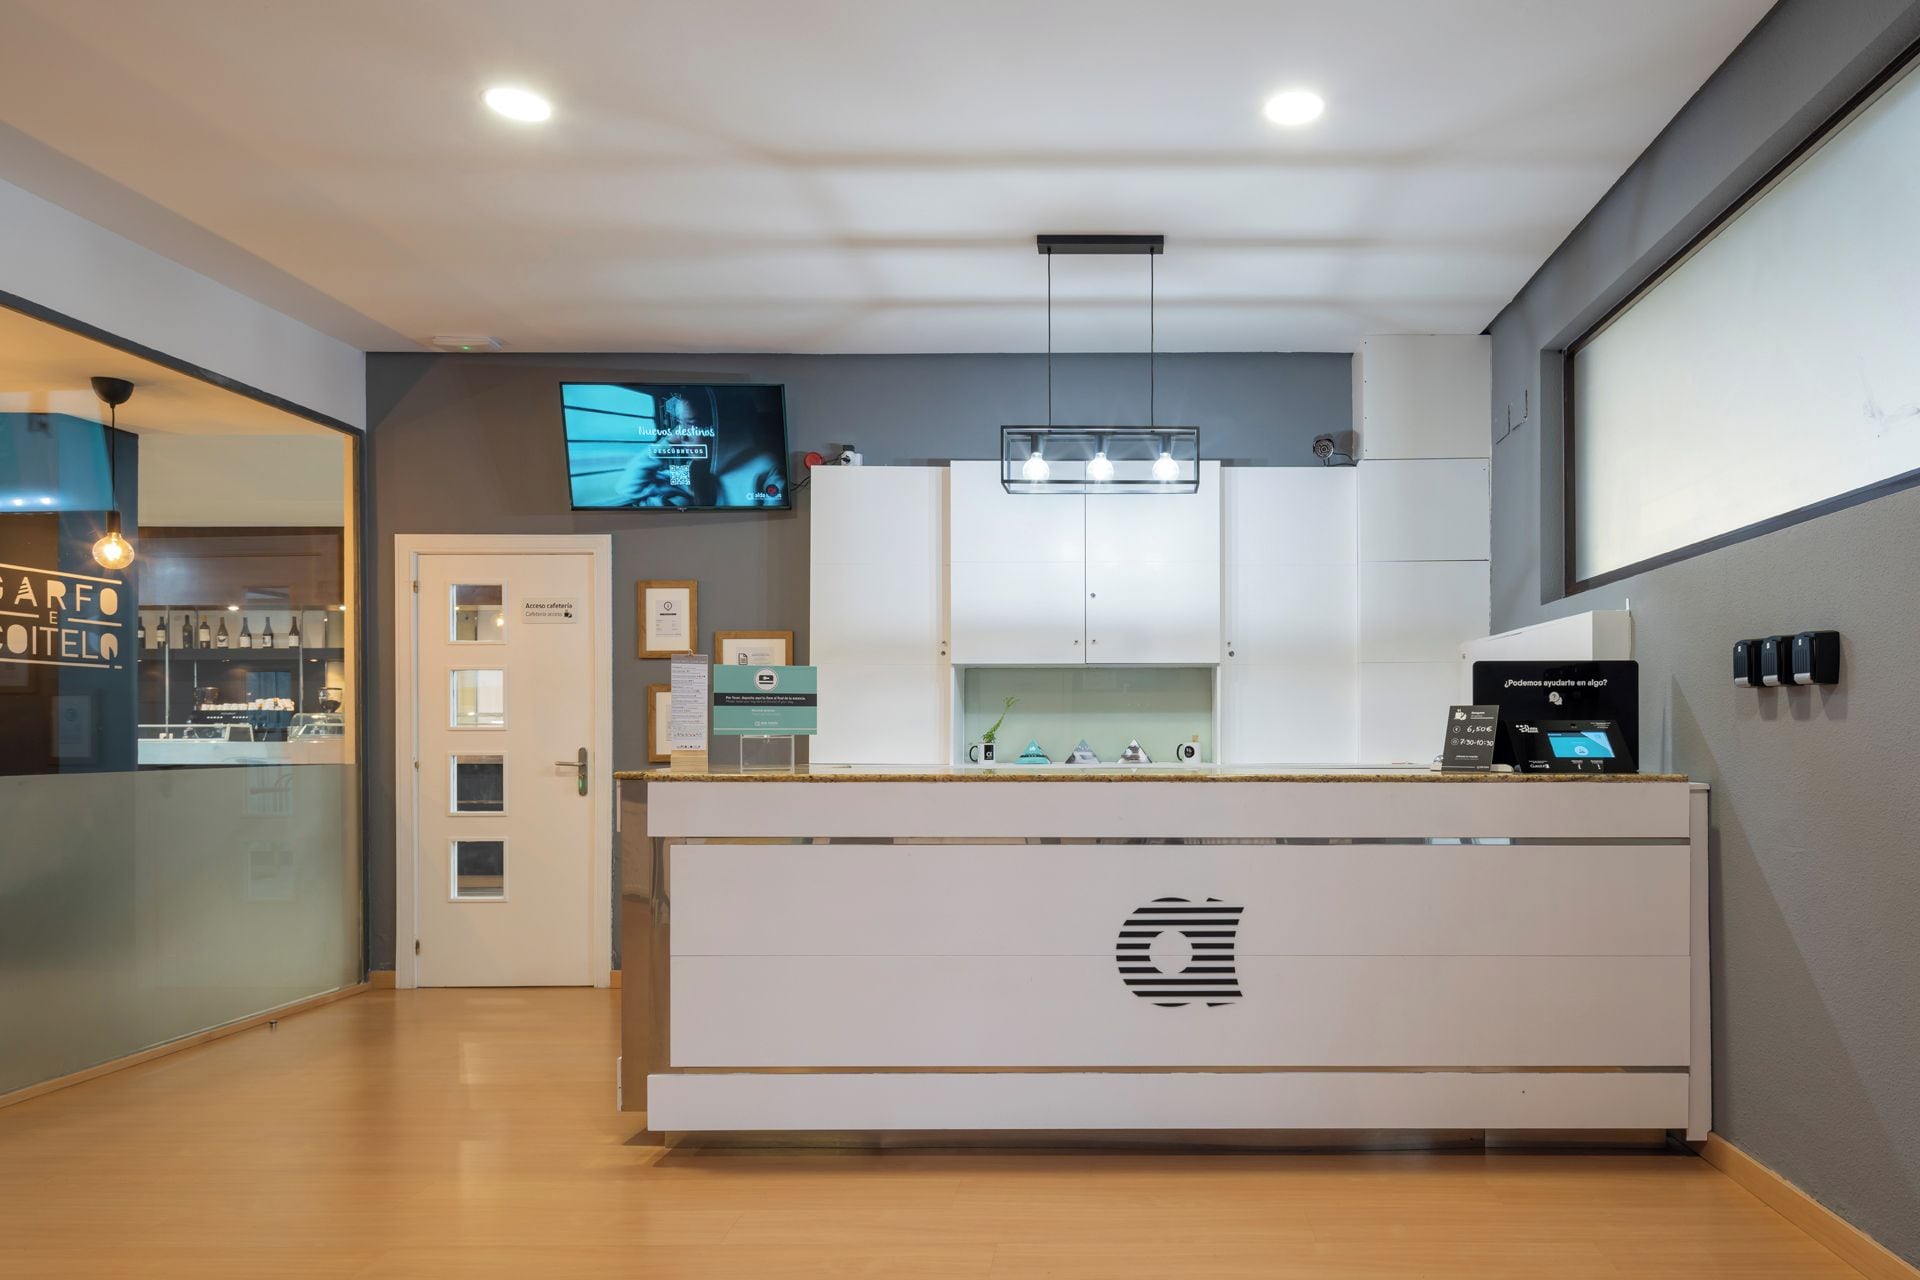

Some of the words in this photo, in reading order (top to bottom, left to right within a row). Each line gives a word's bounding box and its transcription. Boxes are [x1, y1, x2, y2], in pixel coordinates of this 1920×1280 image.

[638, 426, 672, 436] Nuevos
[675, 424, 715, 437] destinos
[0, 576, 118, 616] ARFO
[49, 611, 58, 624] E
[0, 623, 118, 660] OITELO
[1504, 679, 1542, 688] ¿Podemos
[1543, 679, 1575, 688] ayudarte
[1587, 679, 1608, 688] algo?
[1467, 725, 1493, 733] 6,50€
